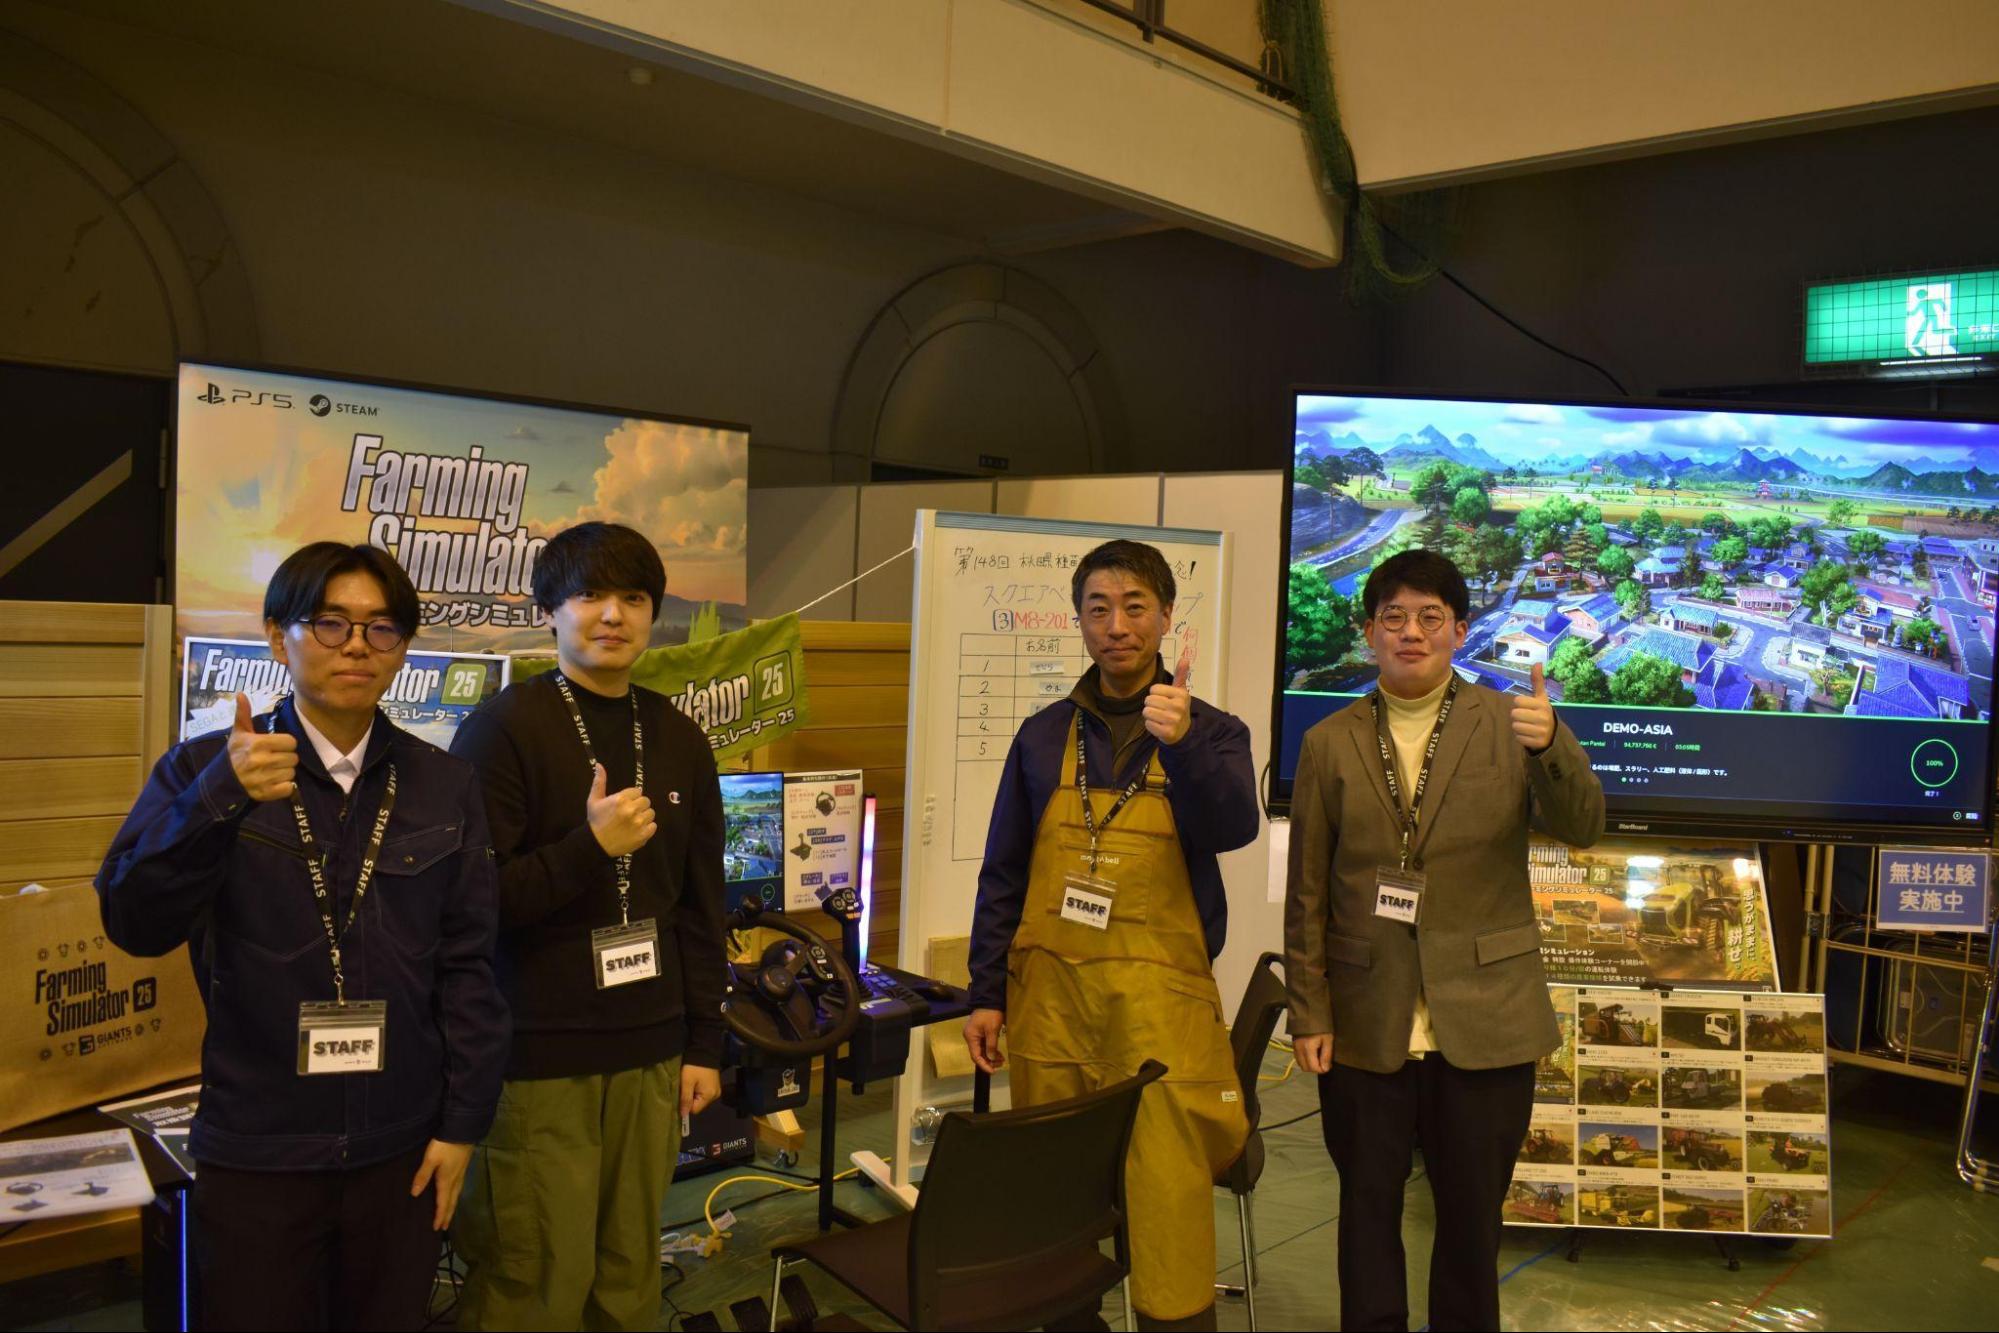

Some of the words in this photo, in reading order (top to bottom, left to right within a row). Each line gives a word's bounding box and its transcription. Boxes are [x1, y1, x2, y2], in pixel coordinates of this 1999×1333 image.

[232, 388, 294, 409] PS5
[336, 403, 379, 416] STEAM
[341, 433, 529, 533] Farming
[369, 513, 550, 596] Simulato
[450, 670, 479, 698] 25
[555, 674, 575, 704] STAFF
[761, 662, 784, 701] 25
[978, 681, 990, 695] 2
[777, 708, 795, 727] 25
[978, 703, 989, 716] 3
[1439, 699, 1453, 723] STAFF
[573, 714, 591, 746] STAFF
[634, 721, 643, 750] STAFF
[978, 720, 990, 732] 4
[1603, 721, 1674, 736] DEMO-ASIA
[978, 741, 988, 756] 5
[1426, 732, 1440, 759] STAFF
[1118, 781, 1139, 806] STAFF
[1386, 769, 1398, 797] STAFF
[1416, 768, 1429, 796] STAFF
[295, 804, 313, 843] STAFF
[371, 808, 390, 846] STAFF
[308, 858, 326, 898] STAFF
[357, 858, 374, 897] STAFF
[1593, 867, 1608, 882] 25
[1889, 861, 1977, 887] 無料体験
[1065, 896, 1107, 917] STAFF
[1379, 894, 1416, 910] STAFF
[1899, 889, 1964, 913] 実施中
[605, 951, 652, 972] STAFF
[35, 959, 107, 1005] Farming
[46, 988, 130, 1037] Simulator
[137, 983, 153, 1007] 25
[96, 1026, 133, 1045] GIANTS
[312, 1038, 376, 1058] STAFF
[722, 1137, 748, 1151] GIANTS
